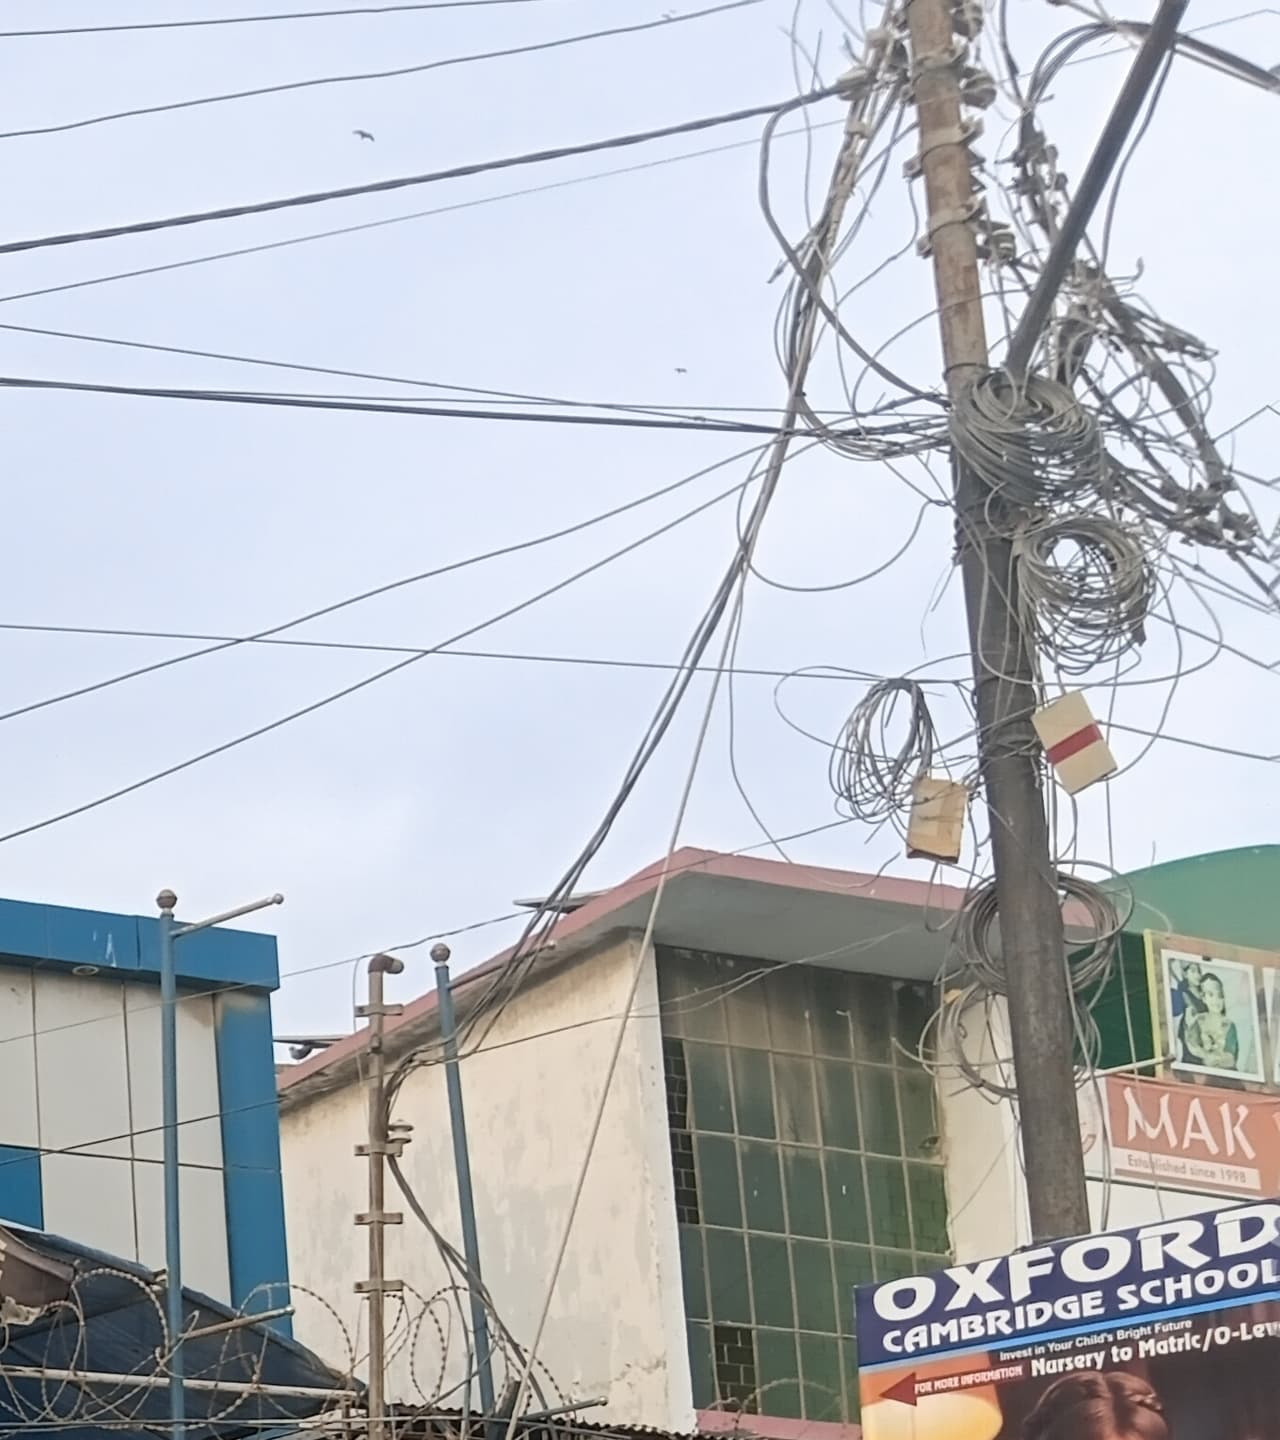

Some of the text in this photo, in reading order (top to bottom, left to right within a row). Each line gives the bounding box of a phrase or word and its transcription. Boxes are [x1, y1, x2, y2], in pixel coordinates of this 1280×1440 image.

[1123, 1086, 1256, 1161] MAK
[1127, 1154, 1246, 1184] Established since 1998
[873, 1204, 1280, 1321] OXFORD
[883, 1258, 1280, 1354] CAMBRIDGE SCHOOL
[999, 1319, 1192, 1361] Invest in Your Child's Bright Future
[1031, 1349, 1106, 1377] Nursery
[1111, 1344, 1132, 1363] to
[914, 1364, 1023, 1395] FOR MORE INFORMATION
